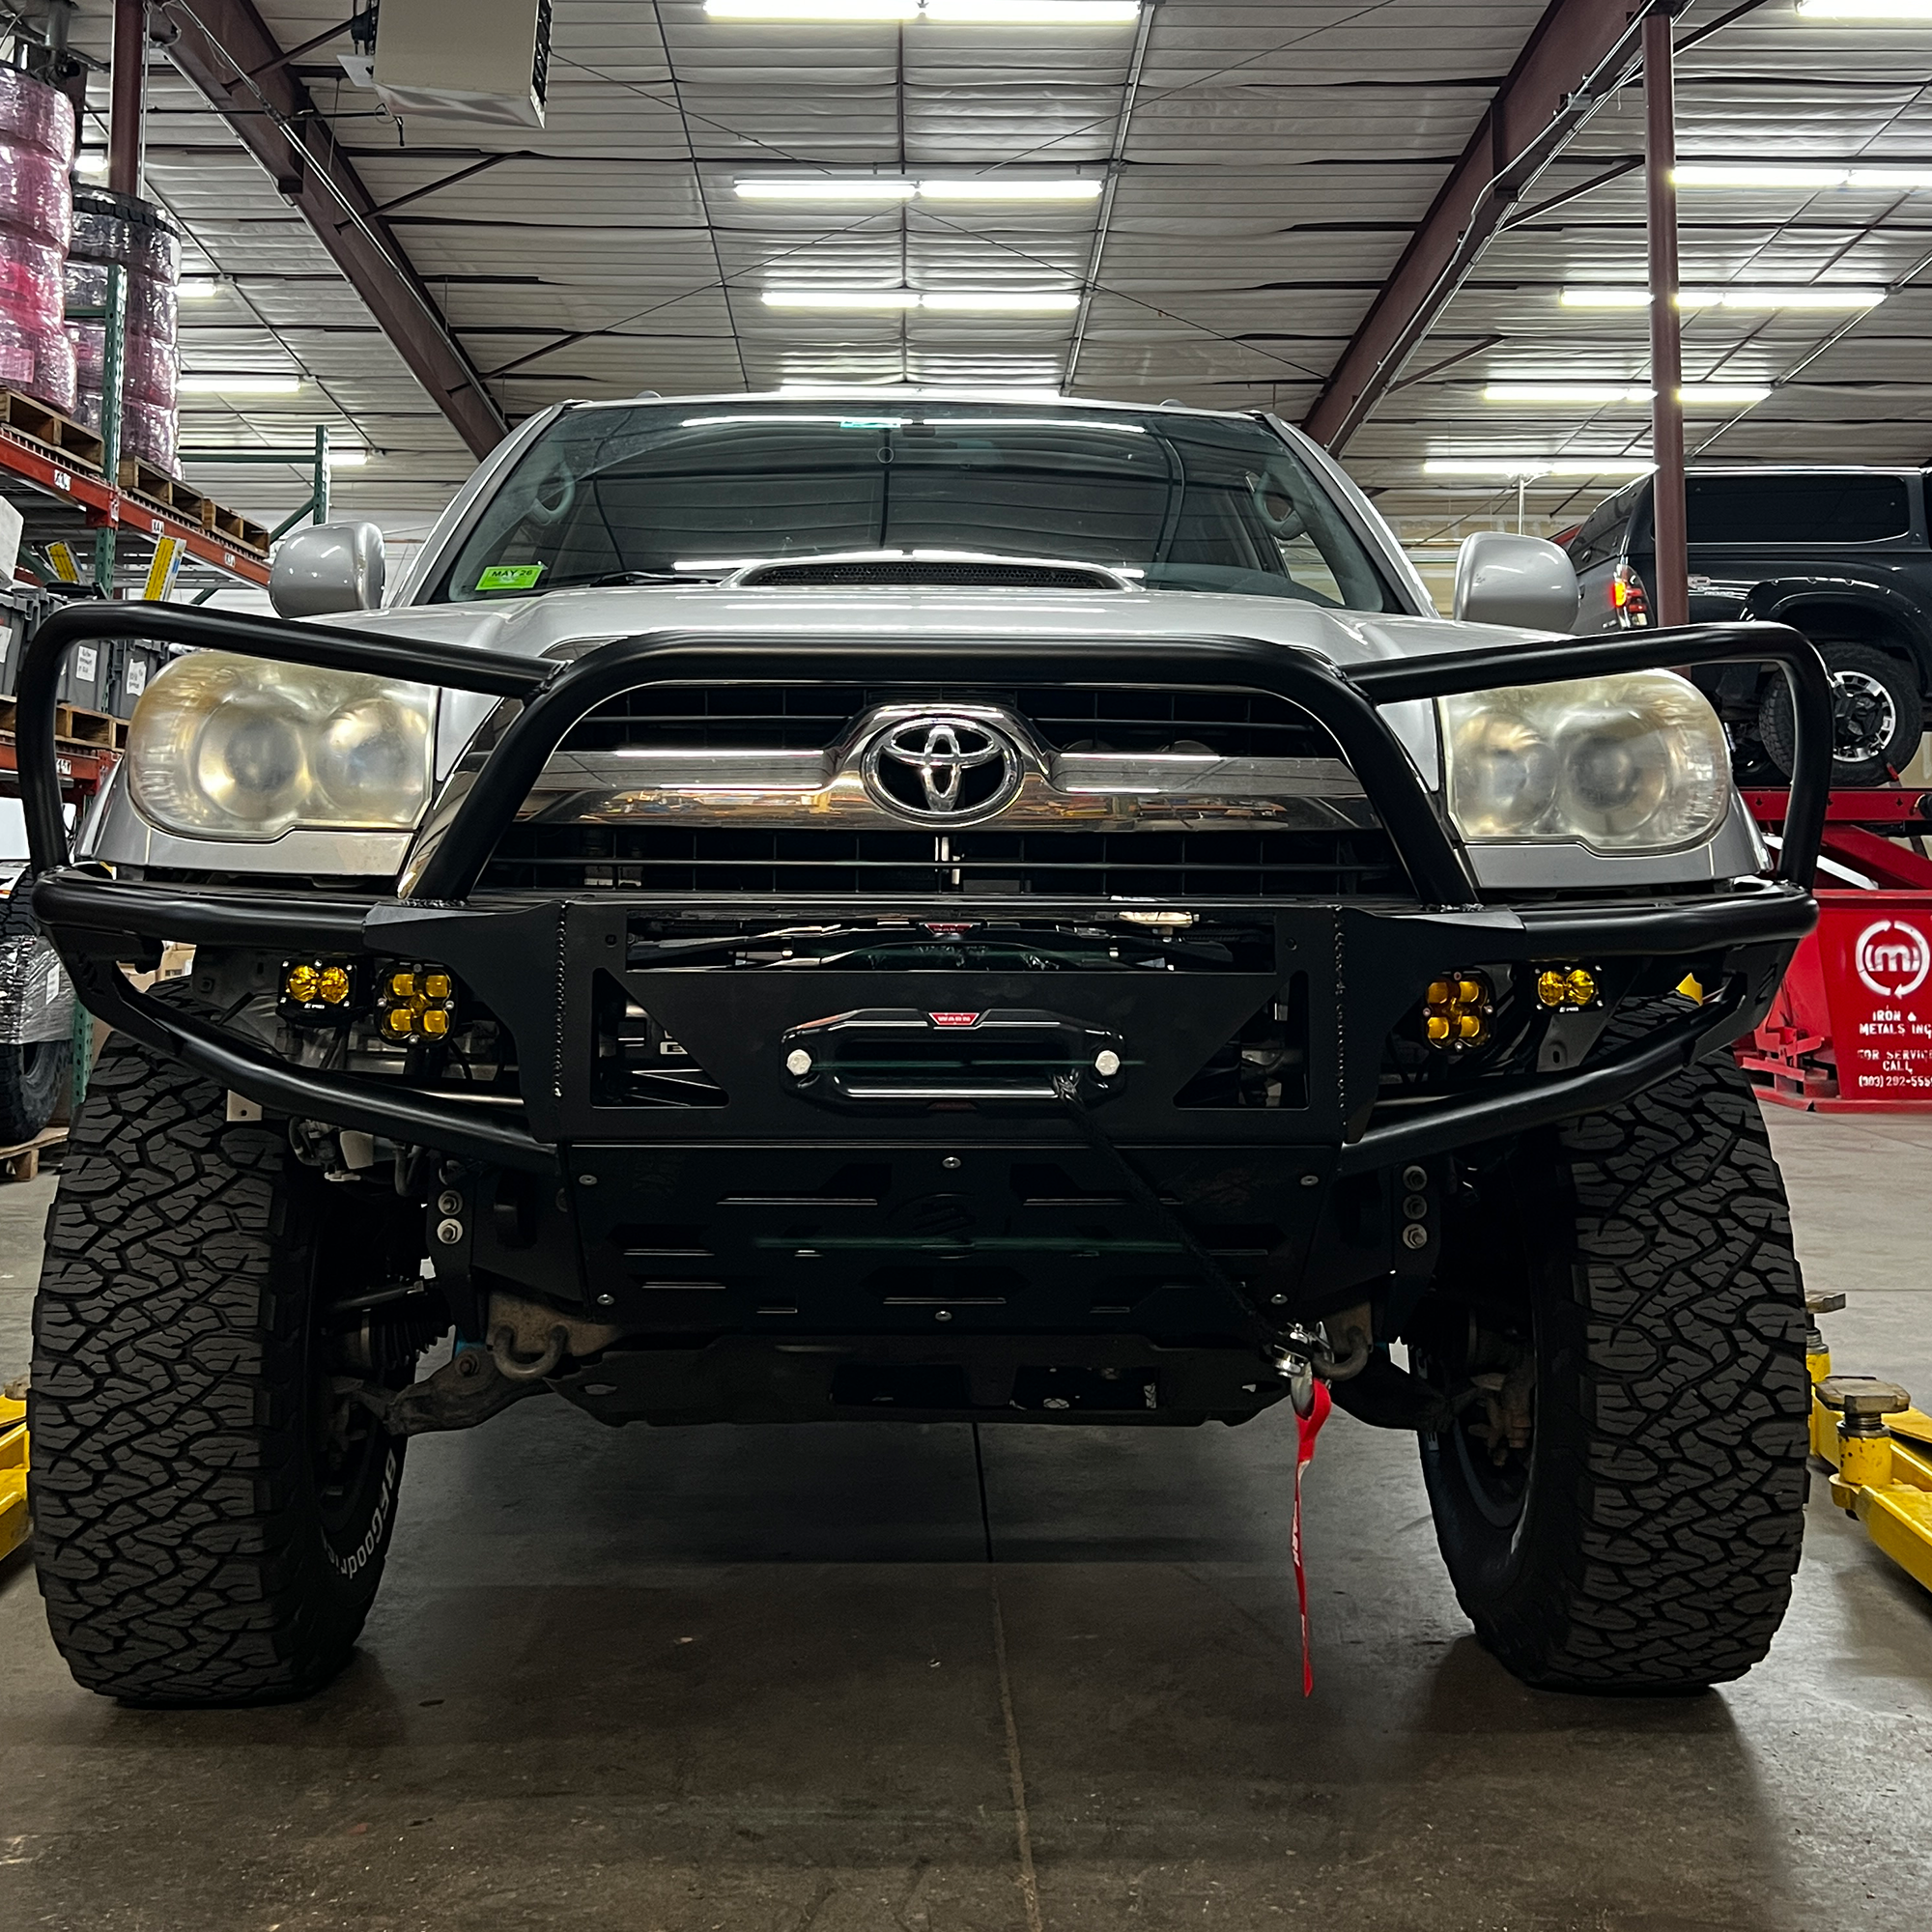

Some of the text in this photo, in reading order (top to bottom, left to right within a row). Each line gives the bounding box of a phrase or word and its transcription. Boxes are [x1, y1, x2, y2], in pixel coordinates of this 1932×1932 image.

[1872, 1009, 1901, 1021] IRON
[1859, 1023, 1906, 1035] METALS
[1883, 1060, 1913, 1072] CALL
[1859, 1074, 1884, 1088] (303)
